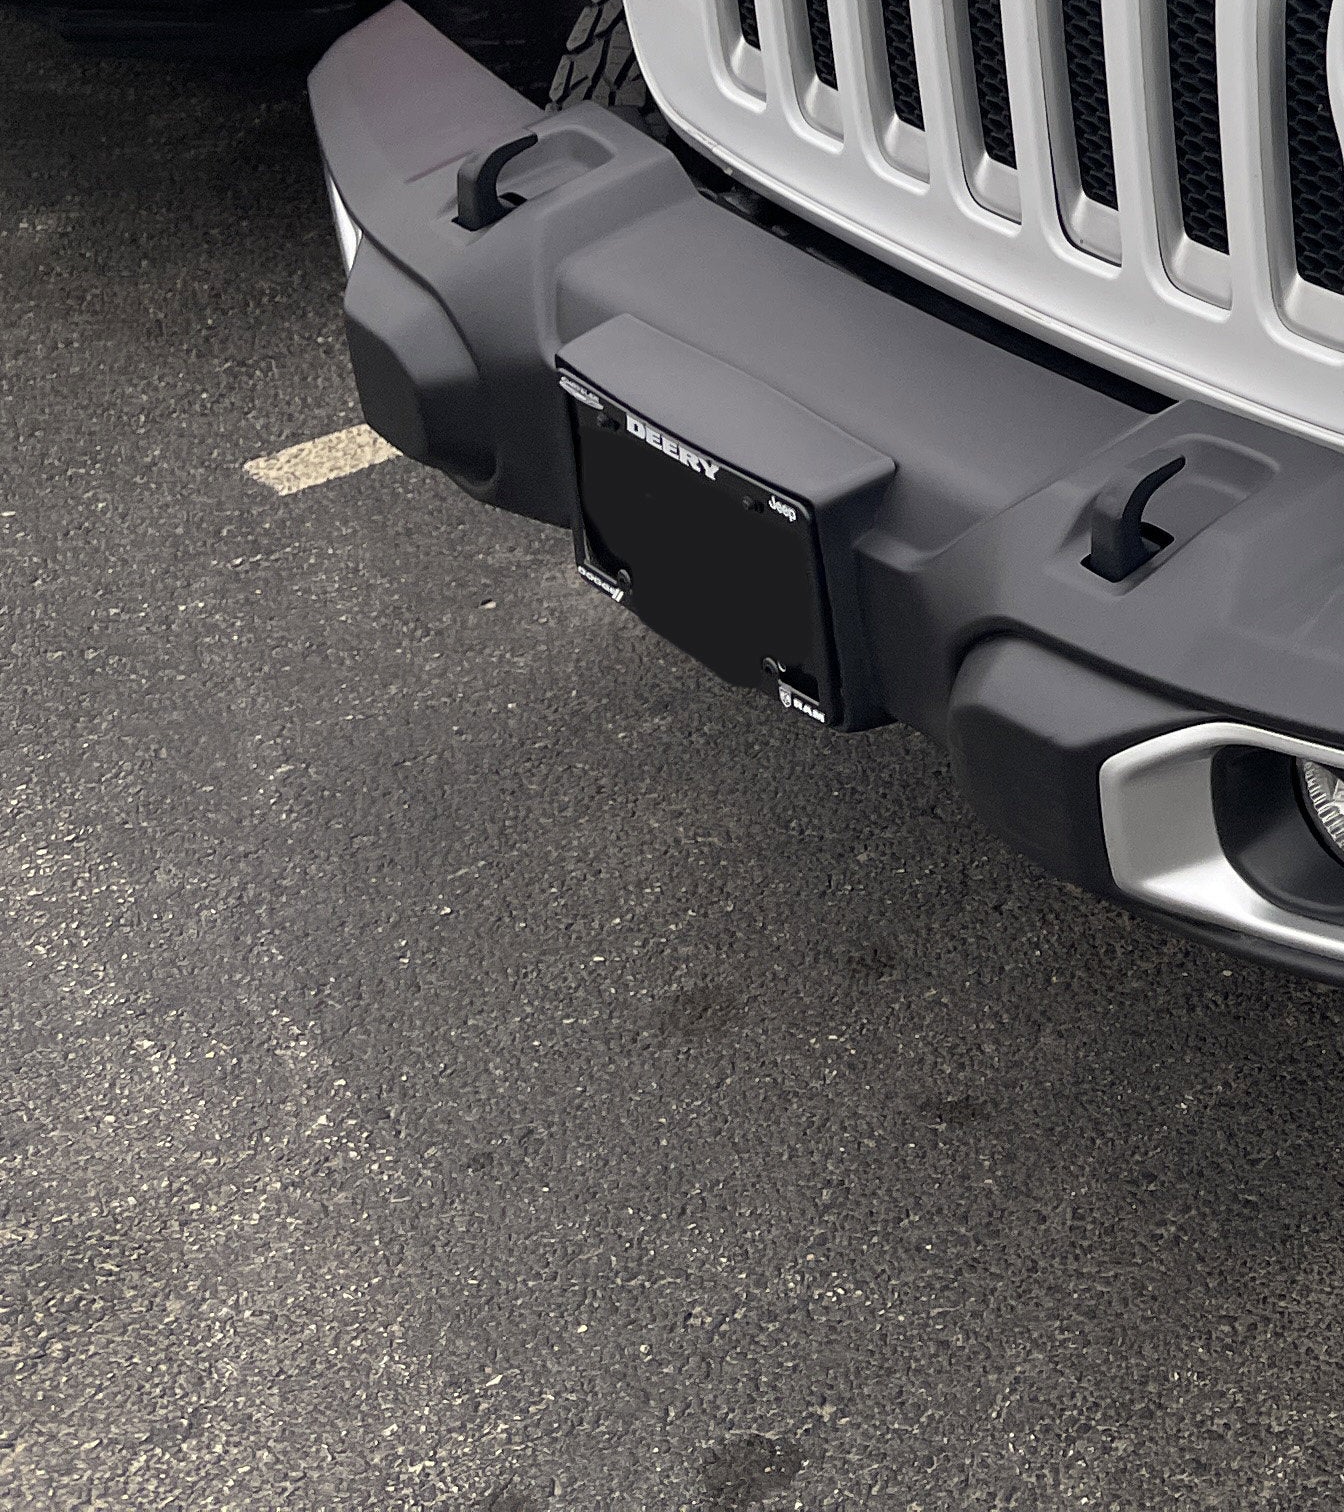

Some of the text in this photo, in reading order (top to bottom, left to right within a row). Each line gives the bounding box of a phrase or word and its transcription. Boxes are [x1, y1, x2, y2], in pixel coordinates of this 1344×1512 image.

[626, 413, 720, 481] DEERY
[768, 495, 797, 523] Jeep
[792, 697, 826, 724] RAM
